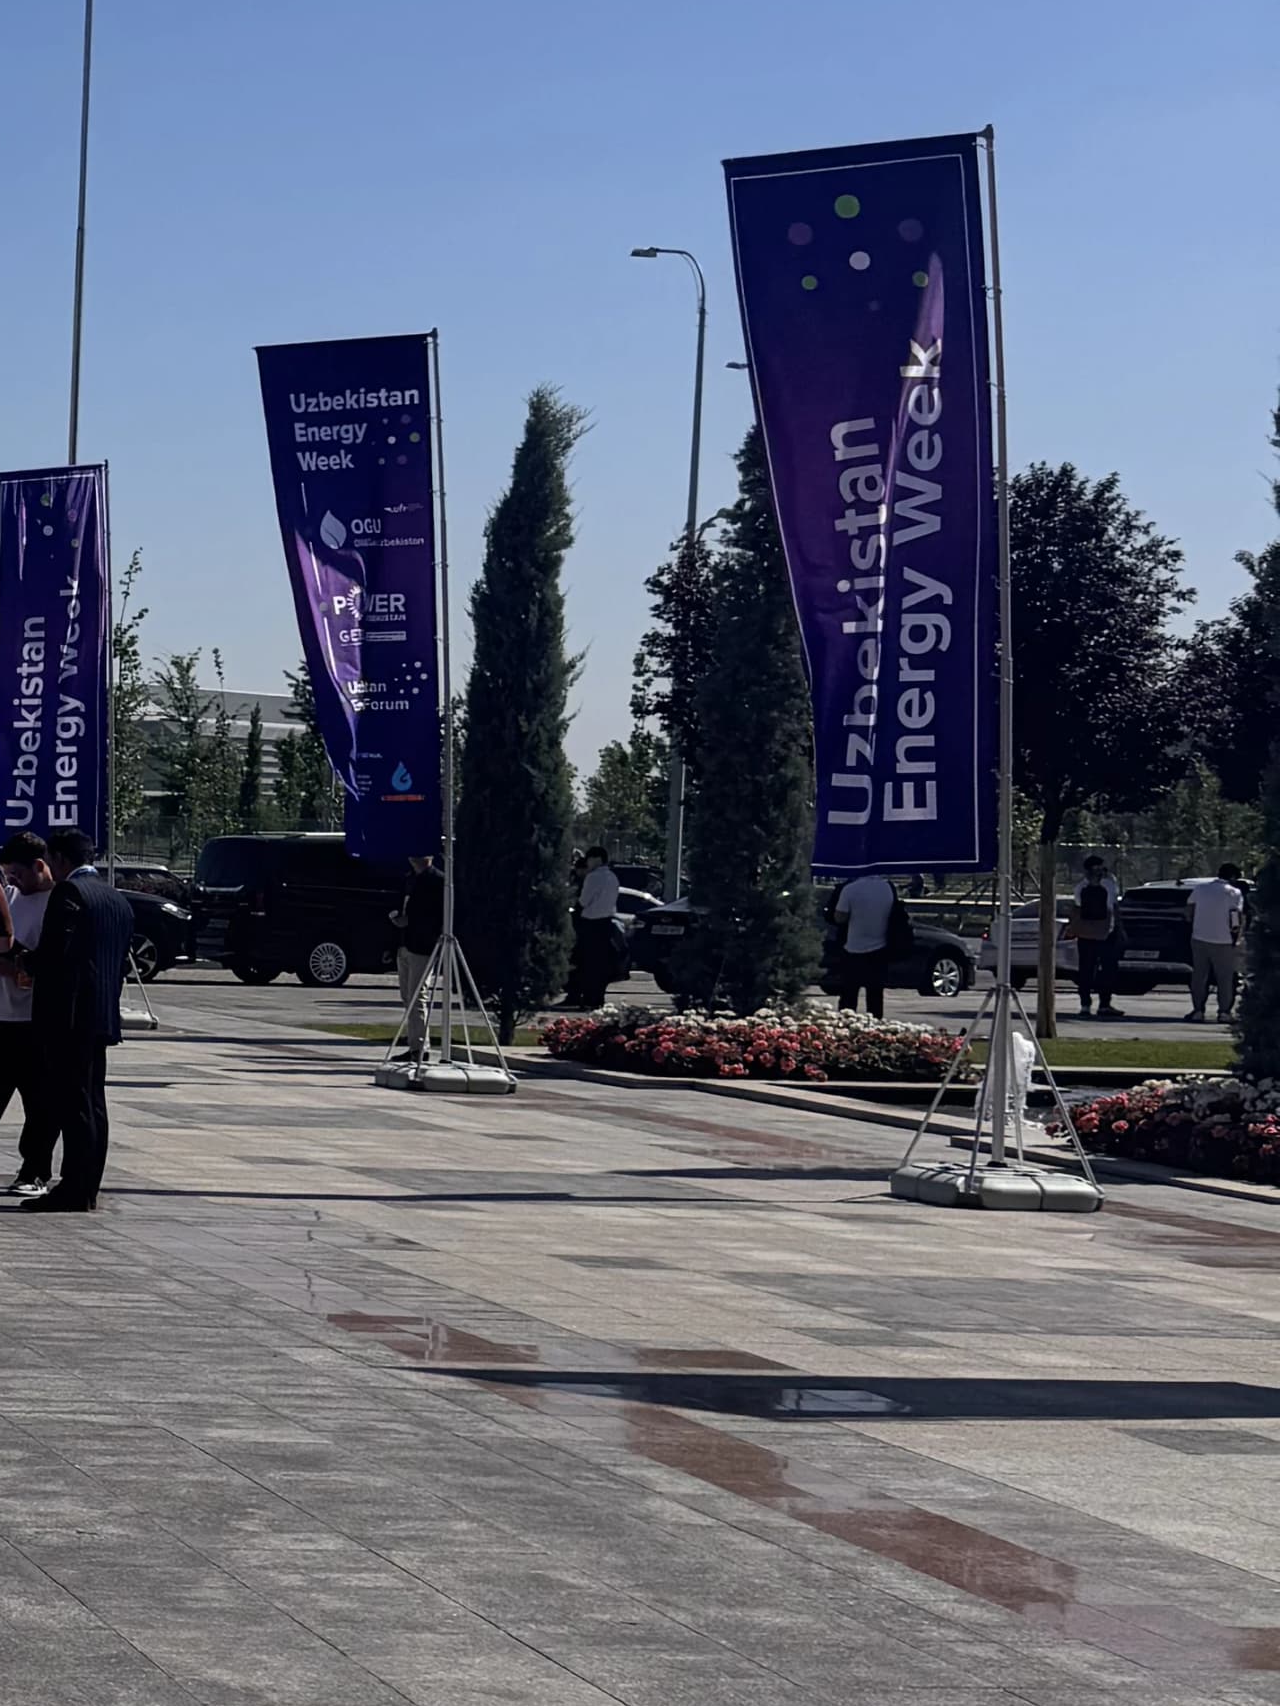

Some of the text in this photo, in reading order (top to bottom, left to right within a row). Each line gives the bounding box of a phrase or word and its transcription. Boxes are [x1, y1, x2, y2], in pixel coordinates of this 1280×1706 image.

[290, 387, 419, 413] Uzbekistan
[294, 422, 368, 444] Energy
[296, 449, 355, 471] Week
[351, 518, 381, 534] OGU
[883, 336, 953, 823] Energy Week
[828, 416, 887, 826] Uzbekistan
[5, 616, 45, 827] Uzbekistan
[48, 693, 85, 826] Energy
